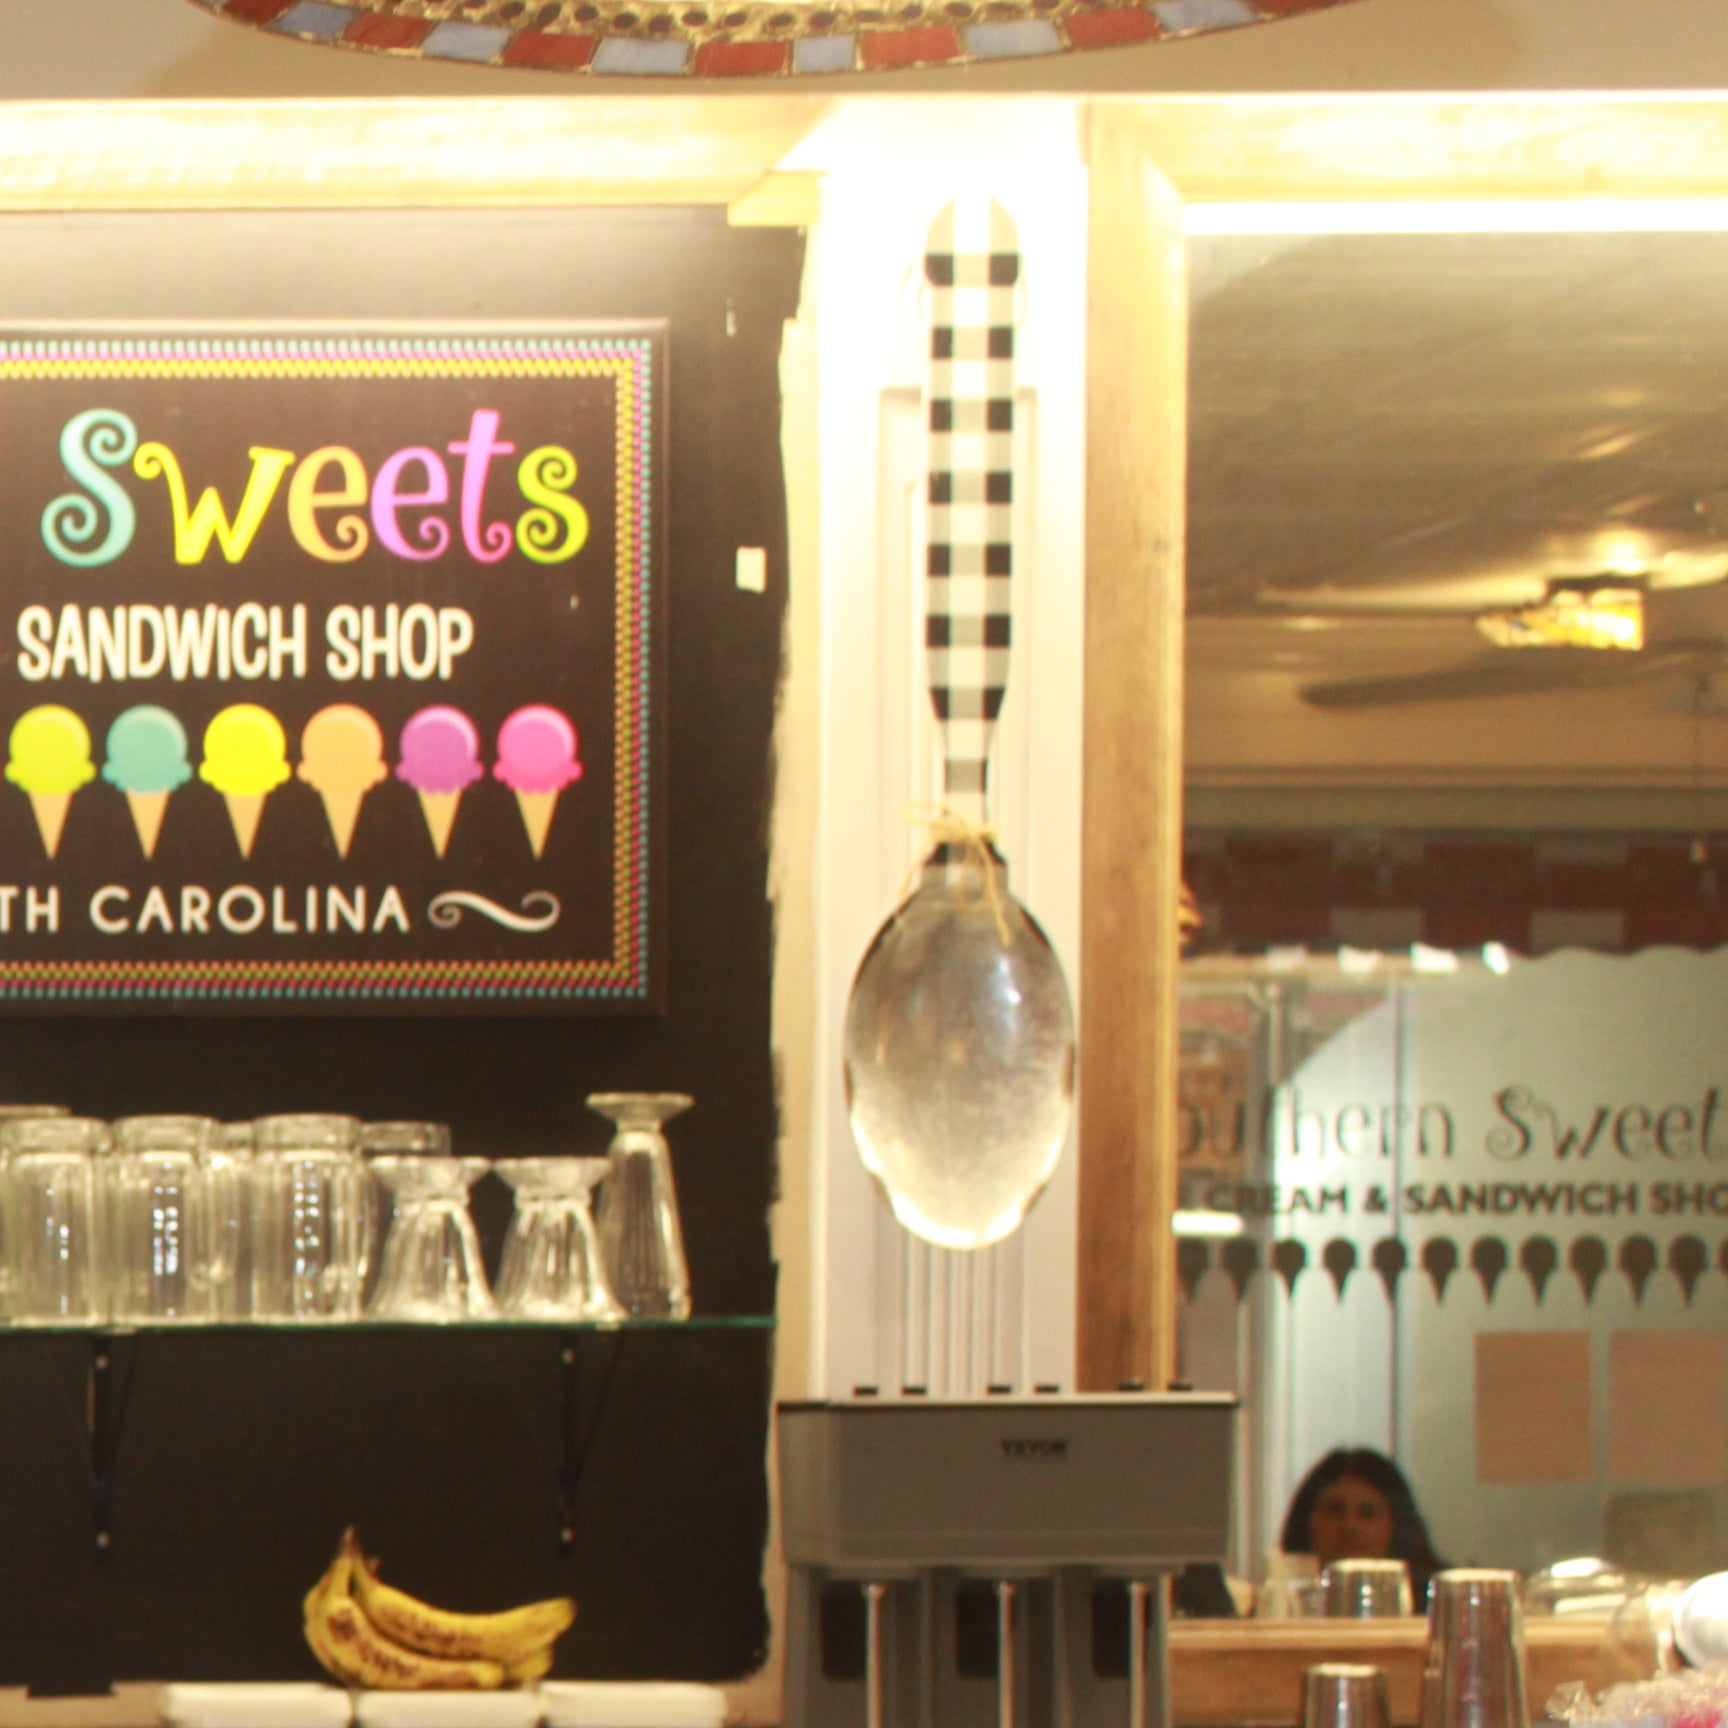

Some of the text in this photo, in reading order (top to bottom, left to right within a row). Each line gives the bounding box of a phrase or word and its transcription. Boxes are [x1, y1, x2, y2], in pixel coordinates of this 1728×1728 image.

[40, 407, 590, 568] Sweets
[17, 603, 307, 683] SANDWICH
[325, 603, 474, 682] SHOP
[89, 885, 411, 934] CAROLINA
[1364, 1184, 1388, 1213] &
[1403, 1183, 1638, 1216] SANDWICH
